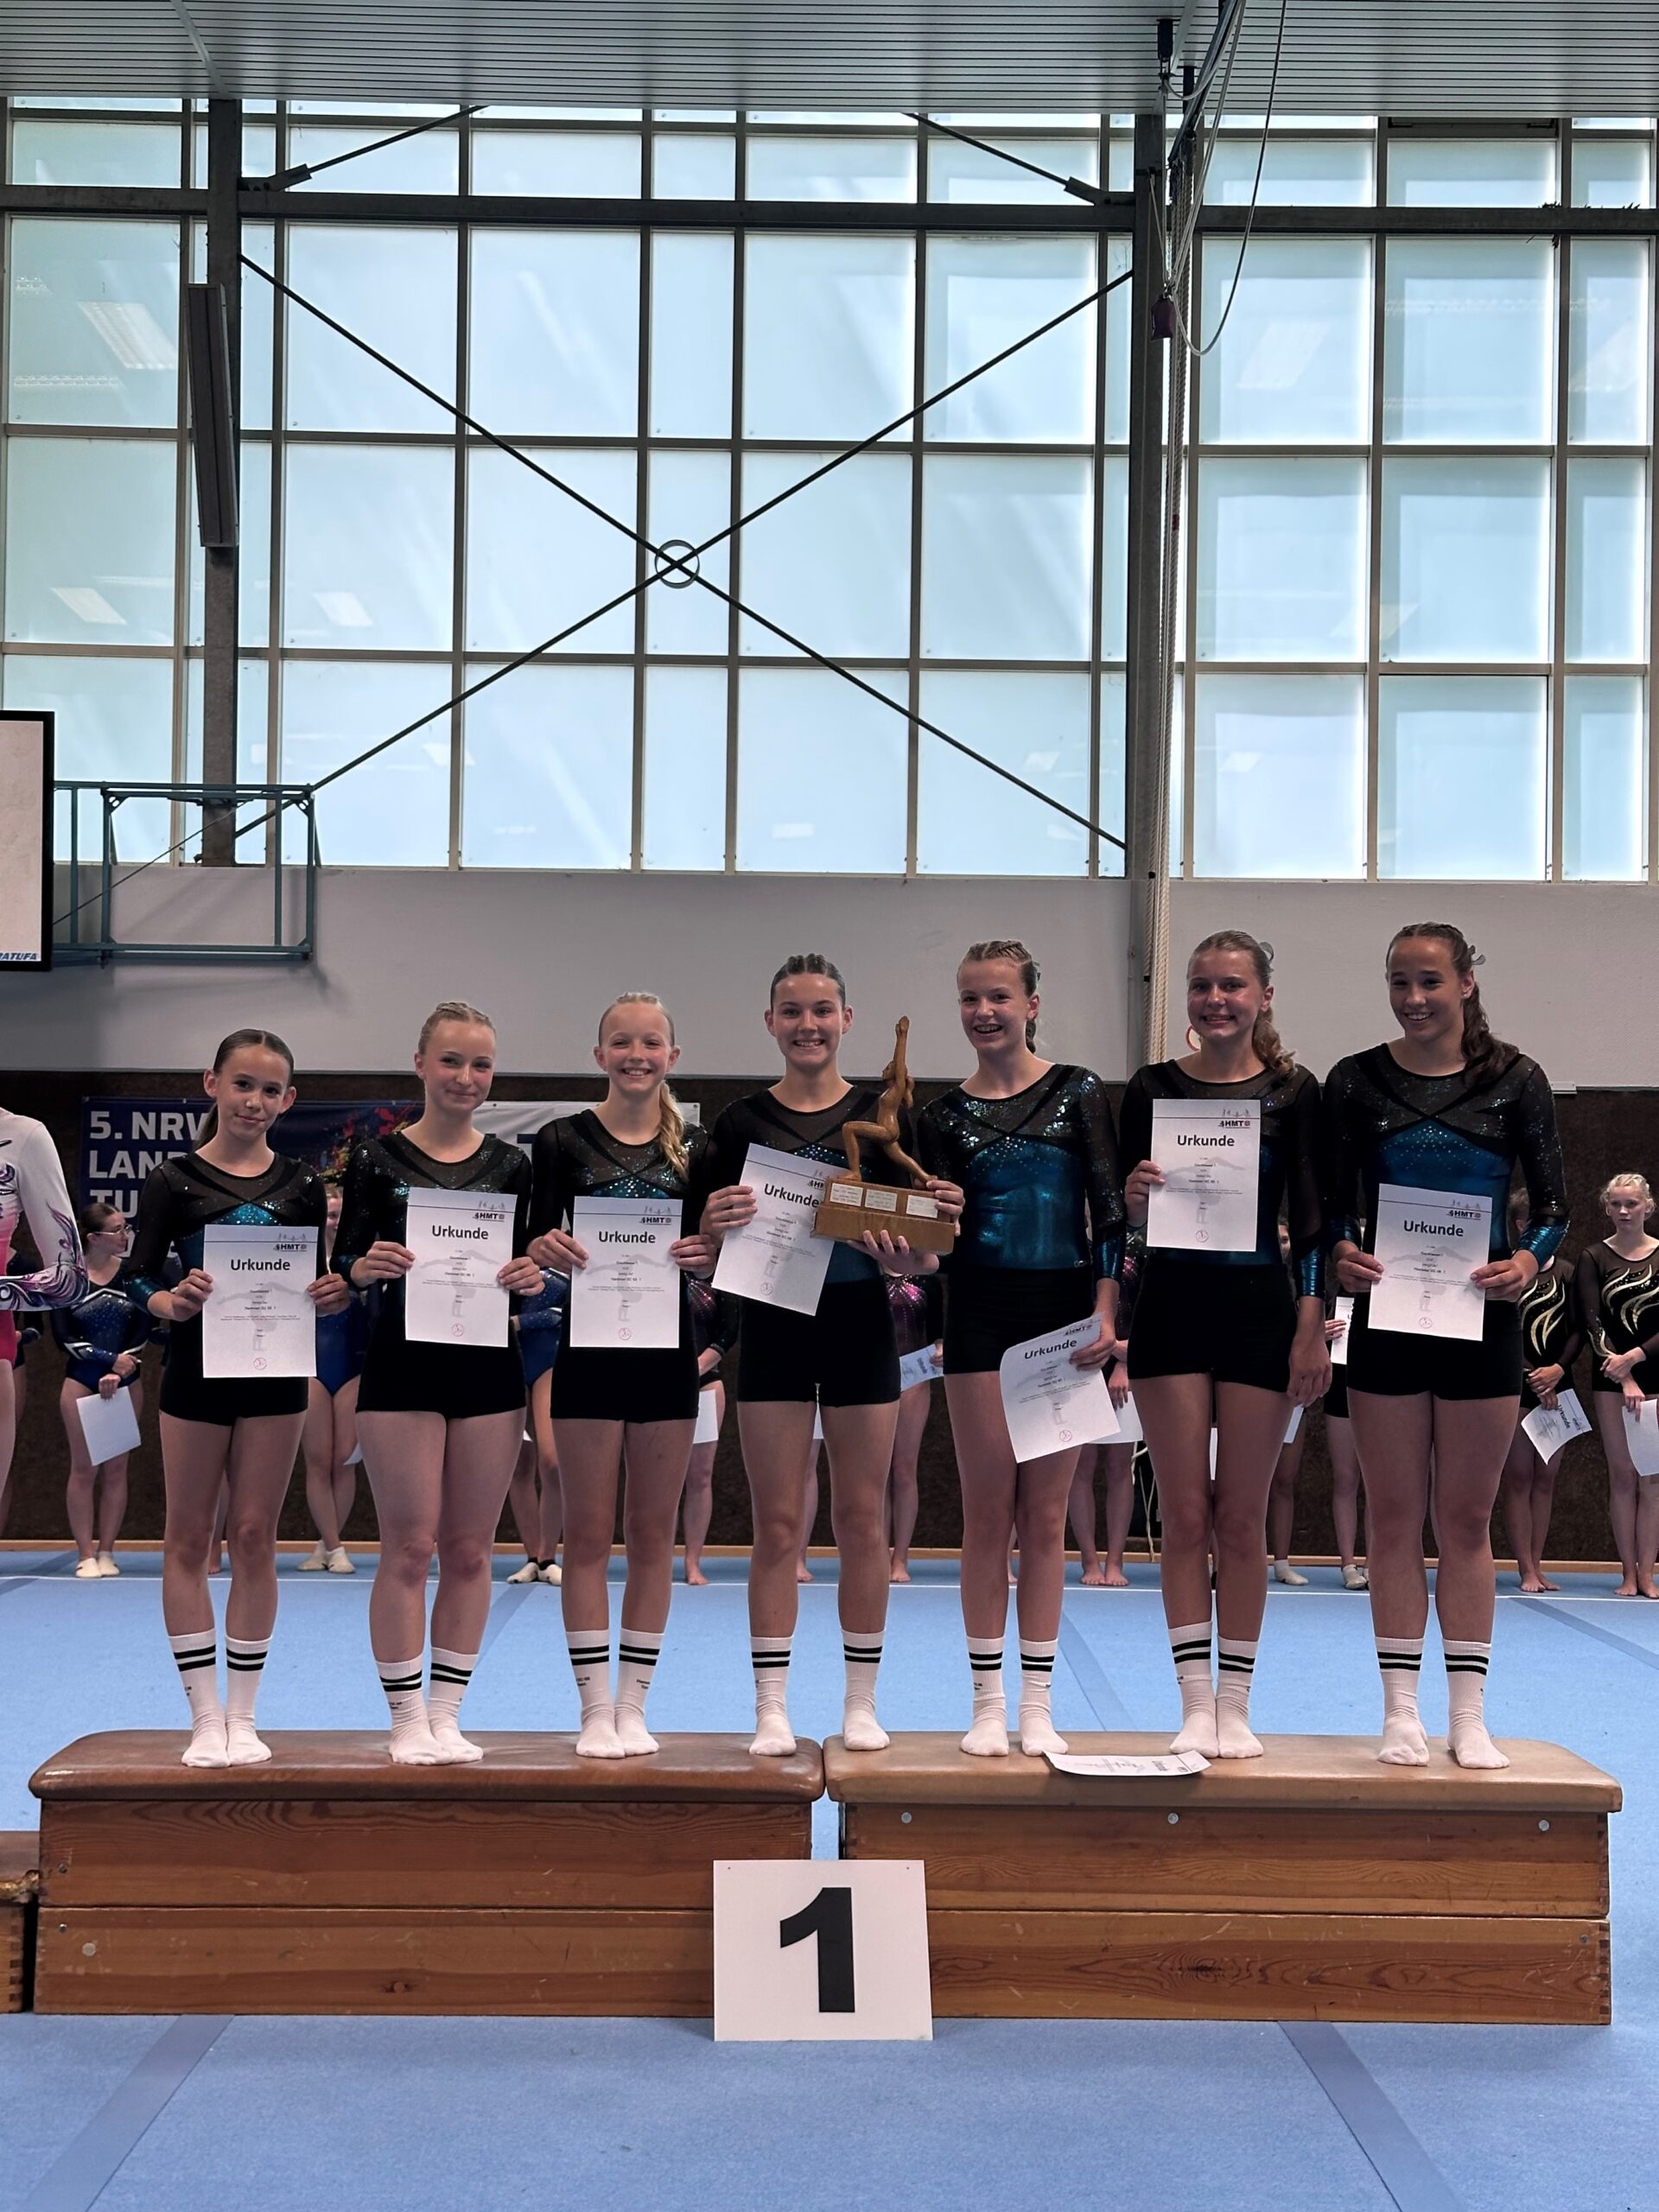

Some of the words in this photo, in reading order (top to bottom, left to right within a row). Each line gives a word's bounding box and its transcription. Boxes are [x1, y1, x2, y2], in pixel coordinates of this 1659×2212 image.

[89, 1110, 123, 1140] 5.
[1177, 1135, 1235, 1147] Urkunde
[88, 1150, 188, 1179] LAN
[764, 1183, 820, 1208] Urkunde
[431, 1224, 489, 1240] Urkunde
[599, 1230, 656, 1243] Urkunde
[1403, 1220, 1464, 1236] Urkunde
[230, 1258, 291, 1271] Urkunde
[1024, 1338, 1077, 1360] Urkunde
[779, 1886, 855, 2013] 1
